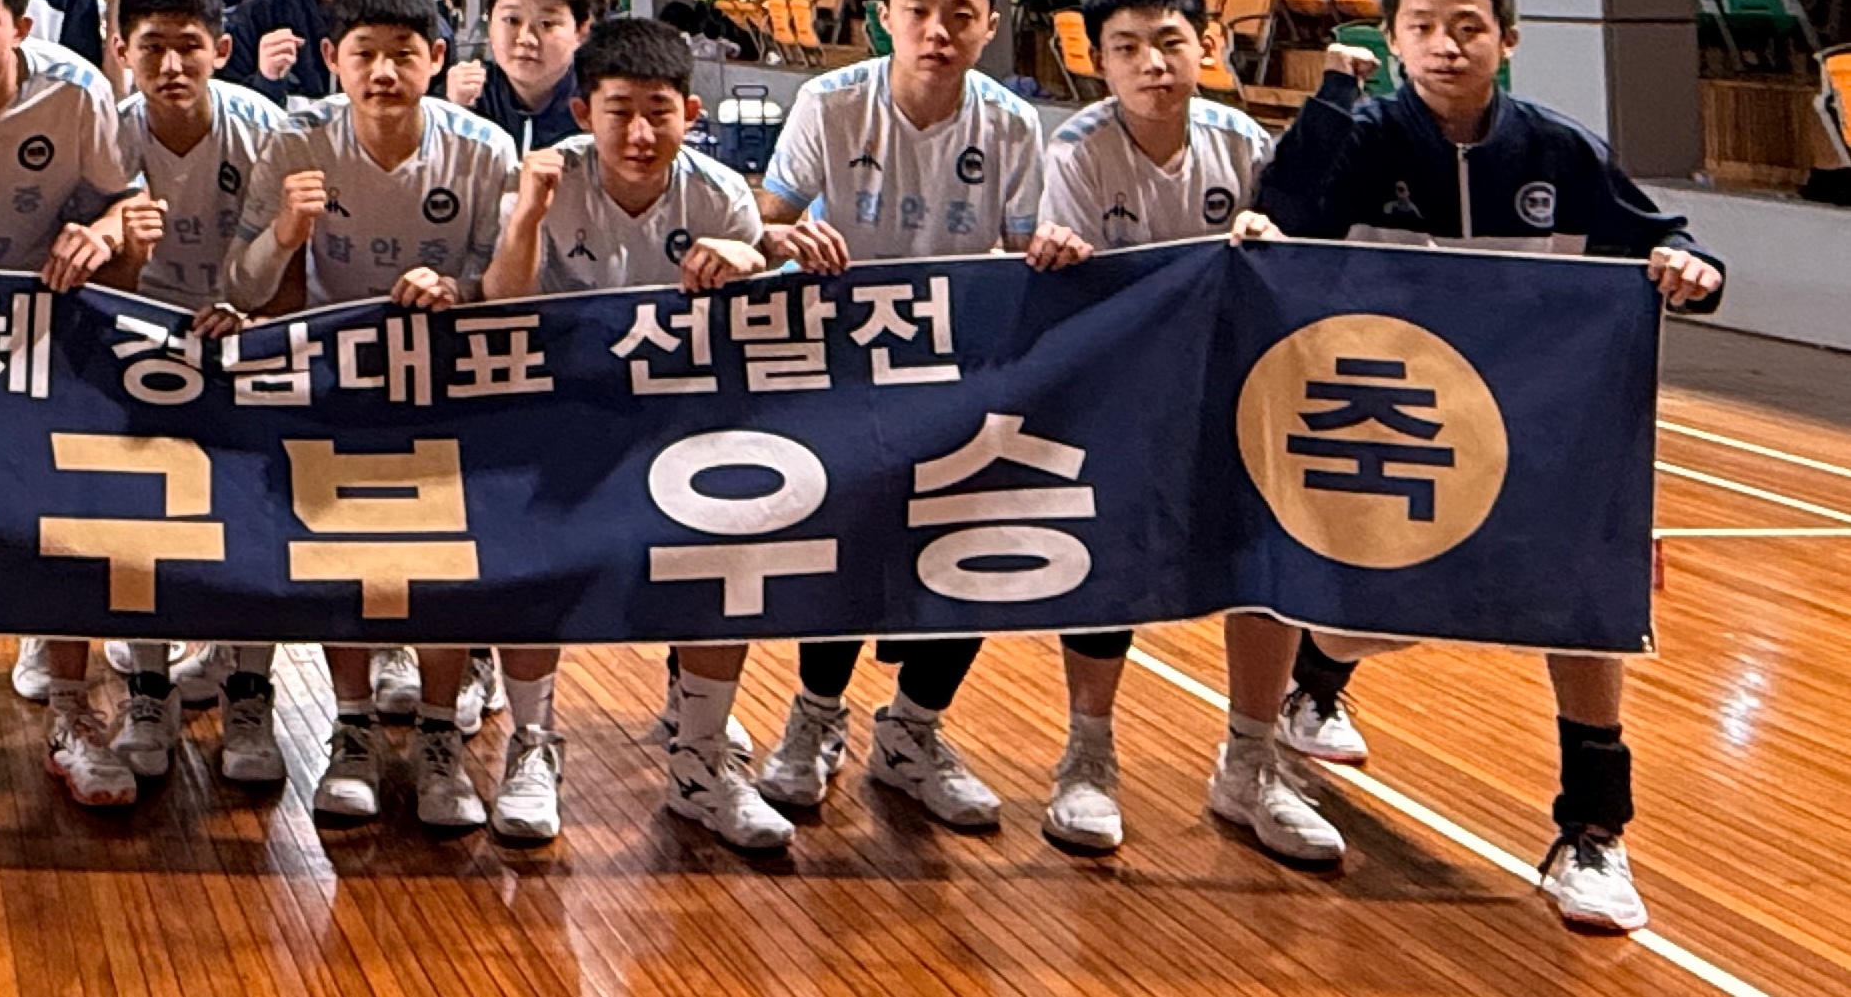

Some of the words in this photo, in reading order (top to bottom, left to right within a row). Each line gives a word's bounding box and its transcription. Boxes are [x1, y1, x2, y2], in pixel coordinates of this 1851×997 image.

[110, 312, 555, 407] 경남대표
[610, 276, 961, 395] 선발전
[646, 412, 1097, 617] 우승
[1285, 356, 1455, 524] 축
